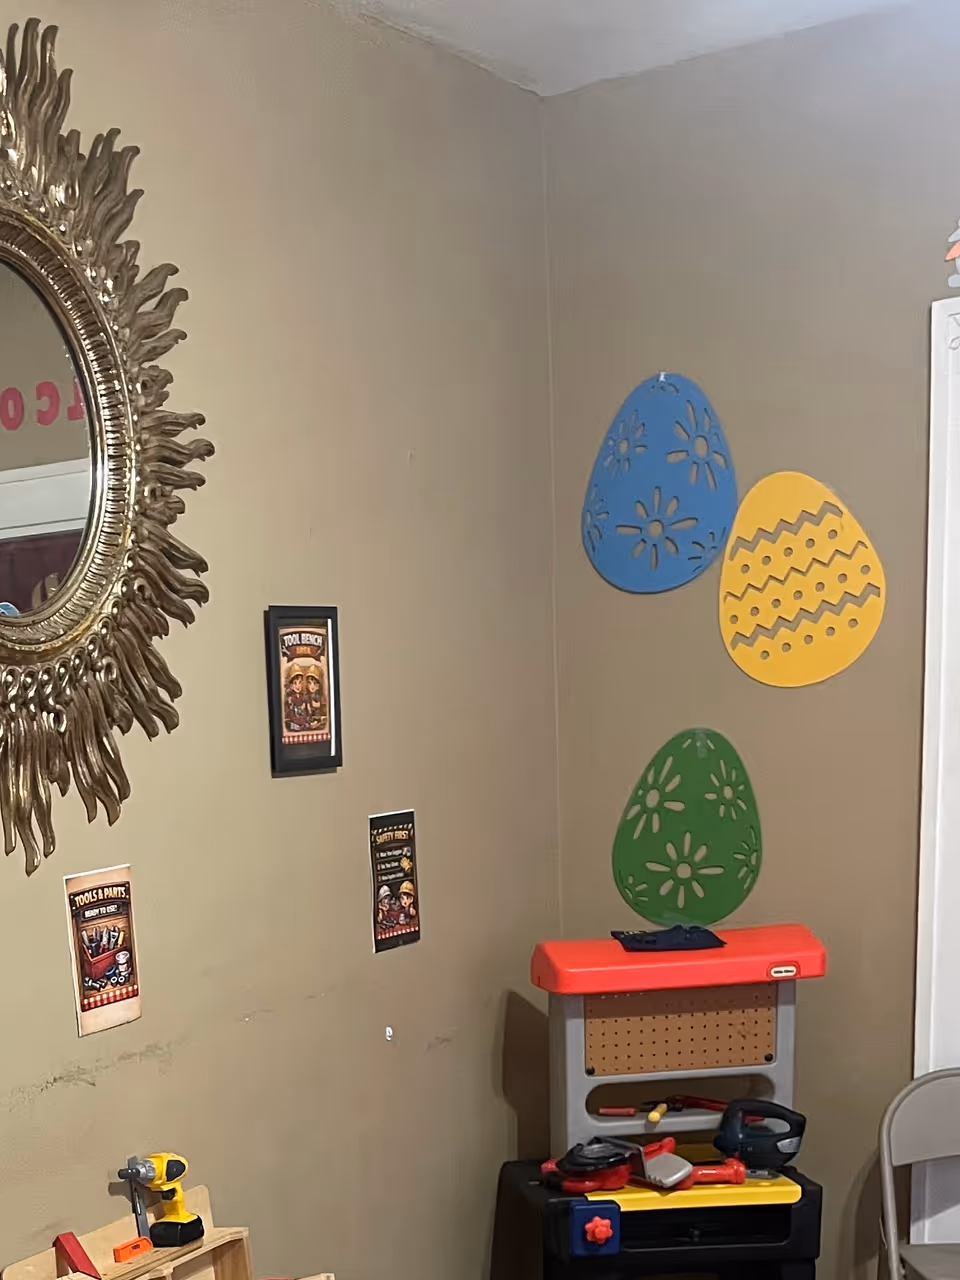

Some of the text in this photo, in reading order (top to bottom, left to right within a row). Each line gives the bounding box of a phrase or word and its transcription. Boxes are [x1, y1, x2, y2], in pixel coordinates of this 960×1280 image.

[283, 633, 322, 647] TOOL BENCH
[75, 886, 126, 908] TOOLS & PARTS
